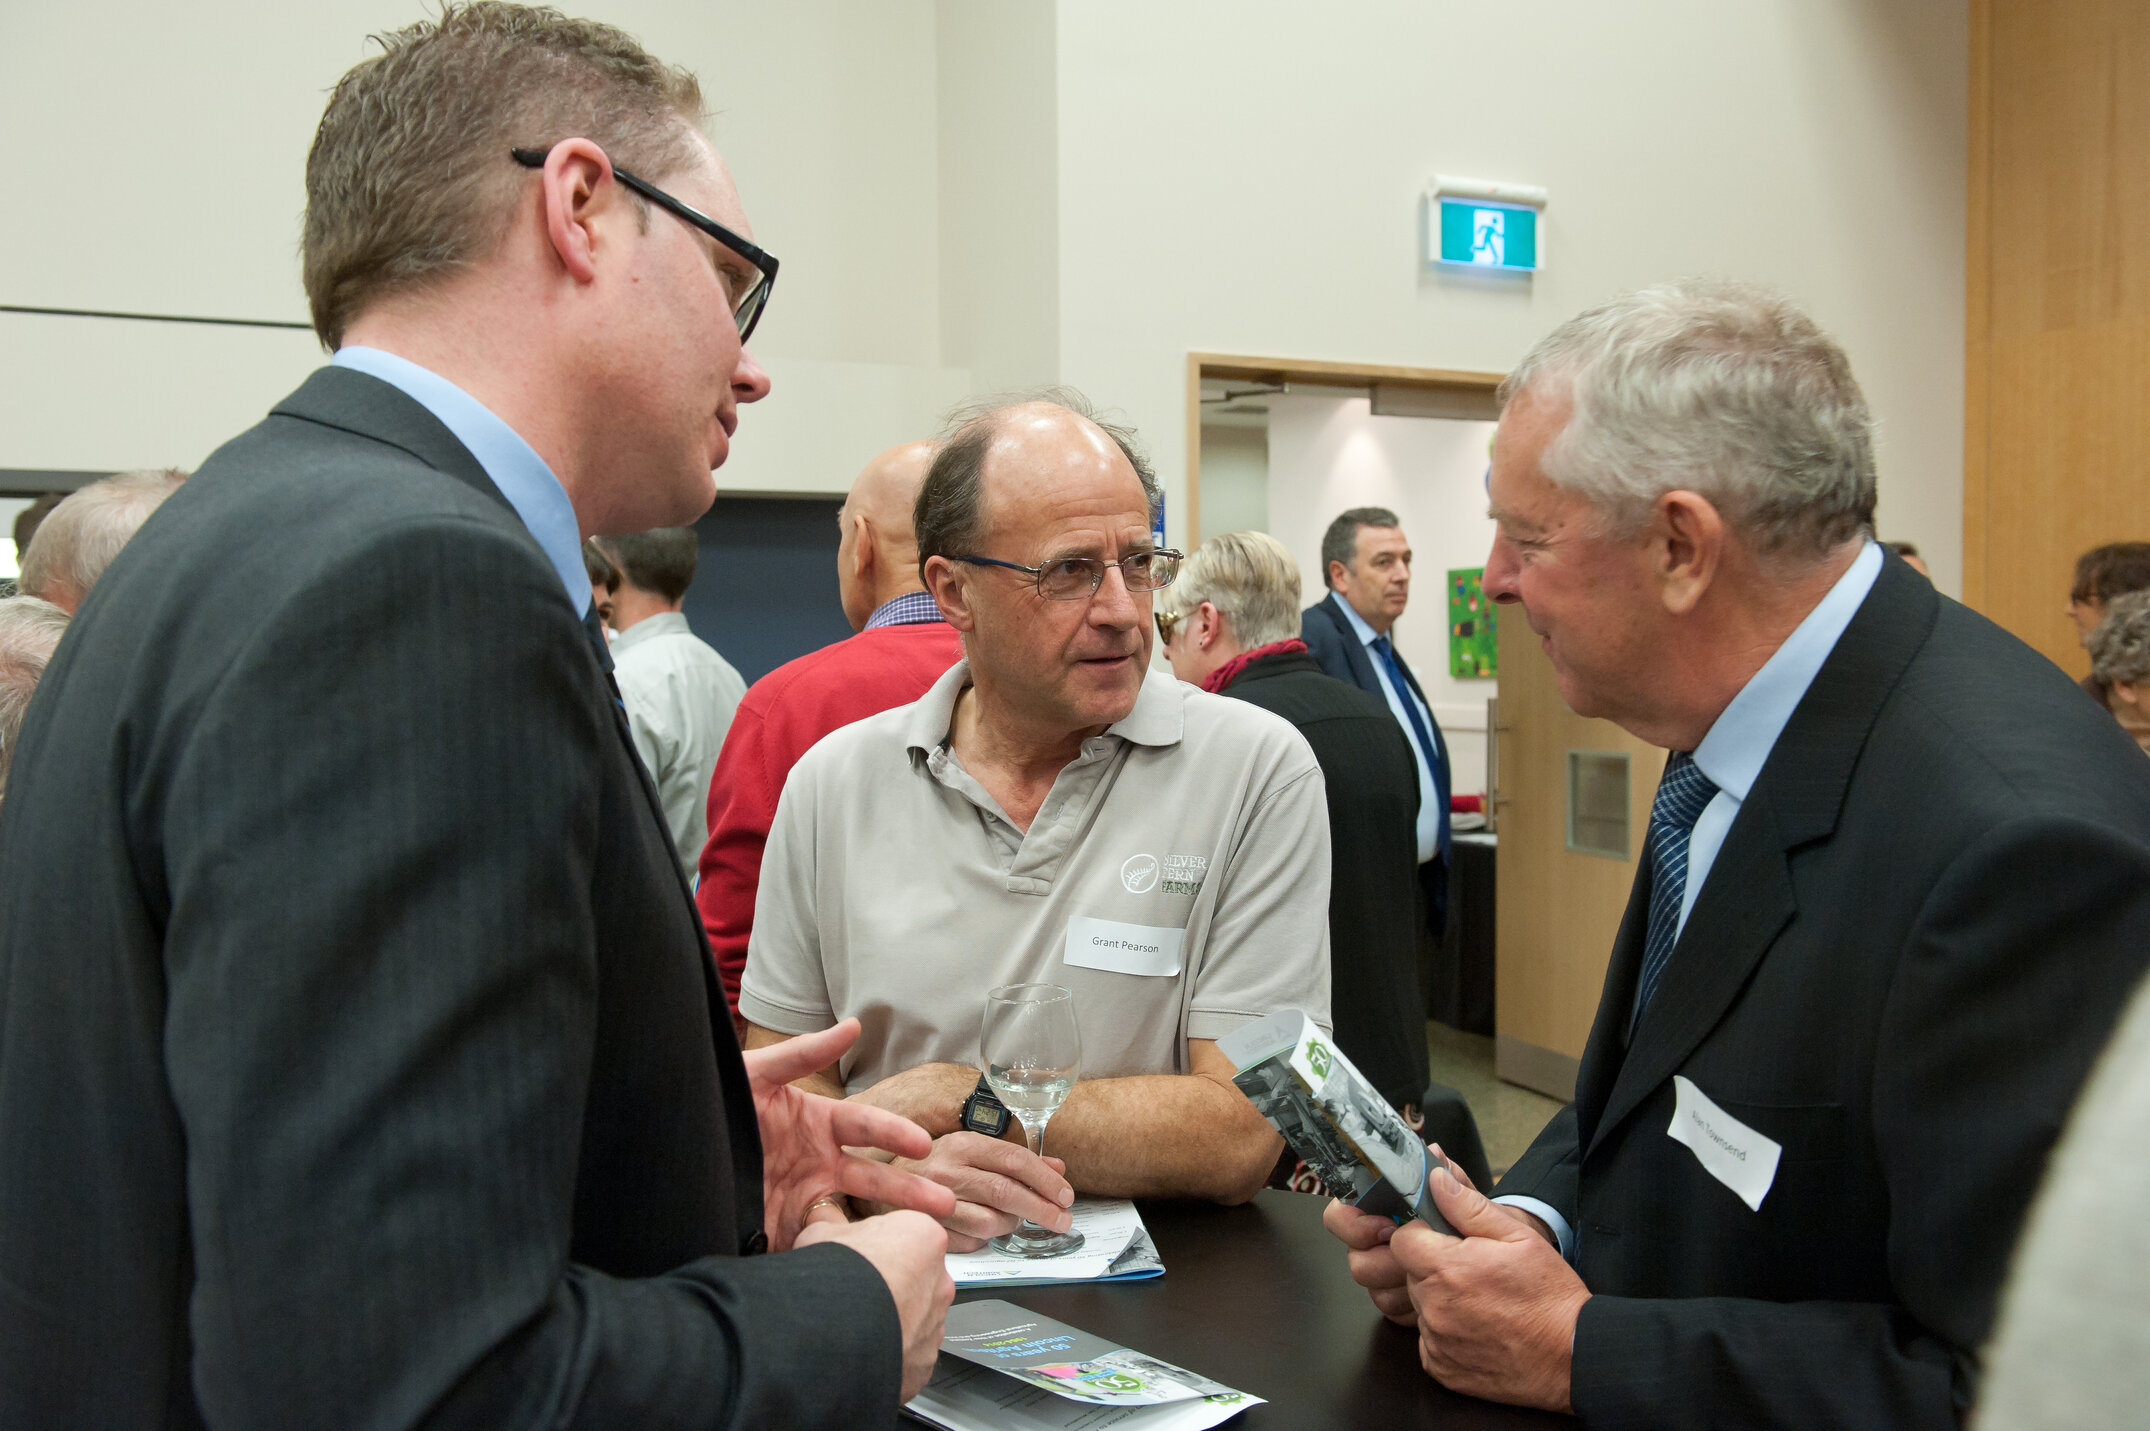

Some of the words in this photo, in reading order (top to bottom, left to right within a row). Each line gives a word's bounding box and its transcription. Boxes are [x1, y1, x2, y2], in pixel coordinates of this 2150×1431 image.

[1163, 854, 1207, 869] SILVER
[1092, 936, 1119, 949] Grant
[1121, 940, 1159, 953] Pearson
[1310, 1045, 1329, 1075] 50
[1706, 1123, 1747, 1161] Townsend
[1022, 1335, 1077, 1348] Lincoln
[1050, 1343, 1072, 1351] 50
[1012, 1347, 1050, 1357] years
[1095, 1375, 1138, 1389] 50
